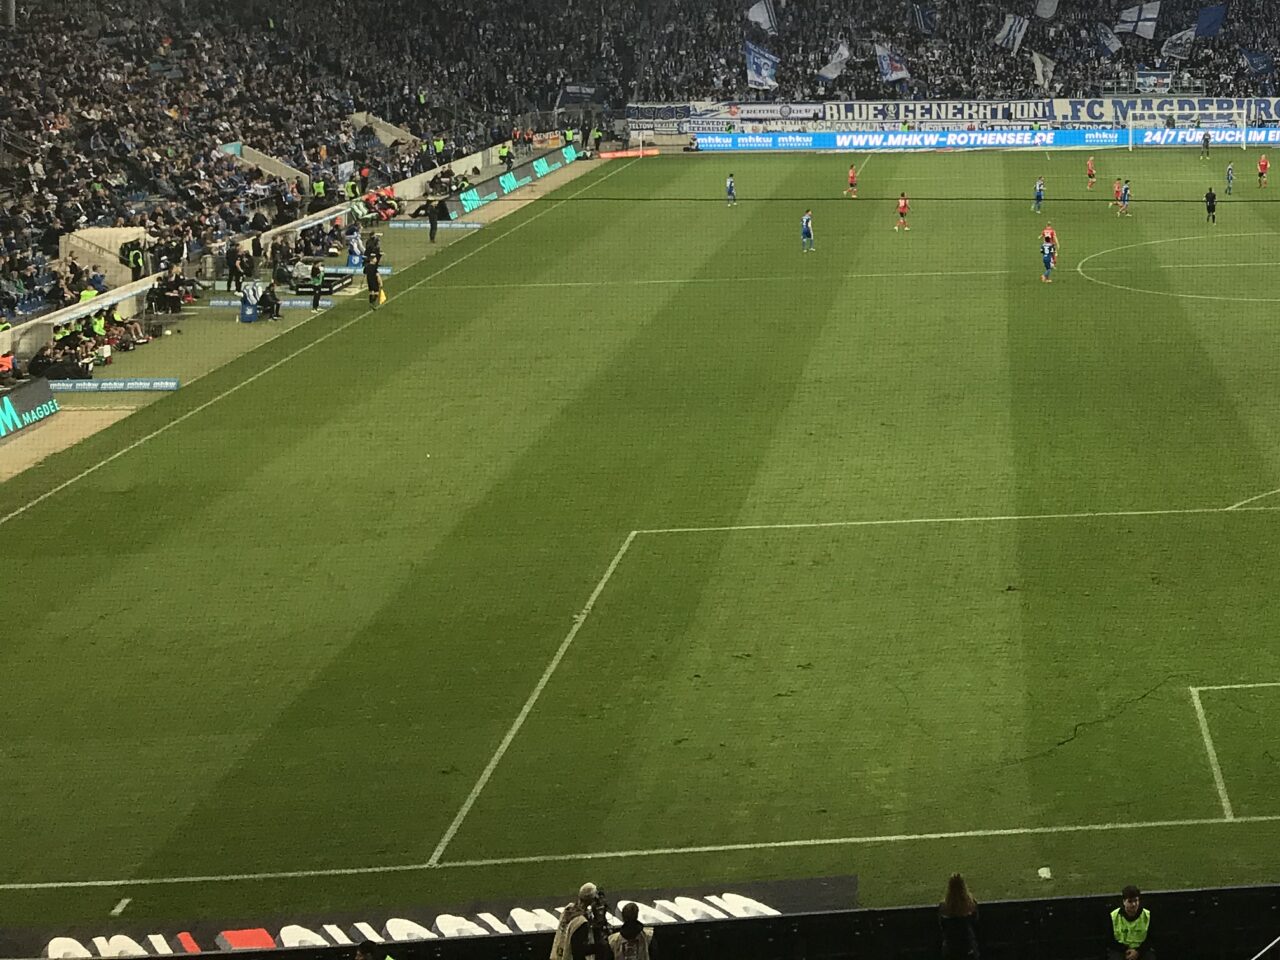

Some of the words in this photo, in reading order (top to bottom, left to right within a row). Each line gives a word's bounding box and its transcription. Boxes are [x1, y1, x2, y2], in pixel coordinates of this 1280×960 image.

[826, 103, 883, 121] BLUE
[899, 102, 1046, 121] GENERATION
[836, 132, 1054, 147] WWW.MHKW-ROTHENSEE.DE
[1085, 132, 1117, 140] mhkw
[1144, 130, 1175, 145] 24/7
[1177, 128, 1203, 143] FÜR
[1248, 130, 1266, 142] IM
